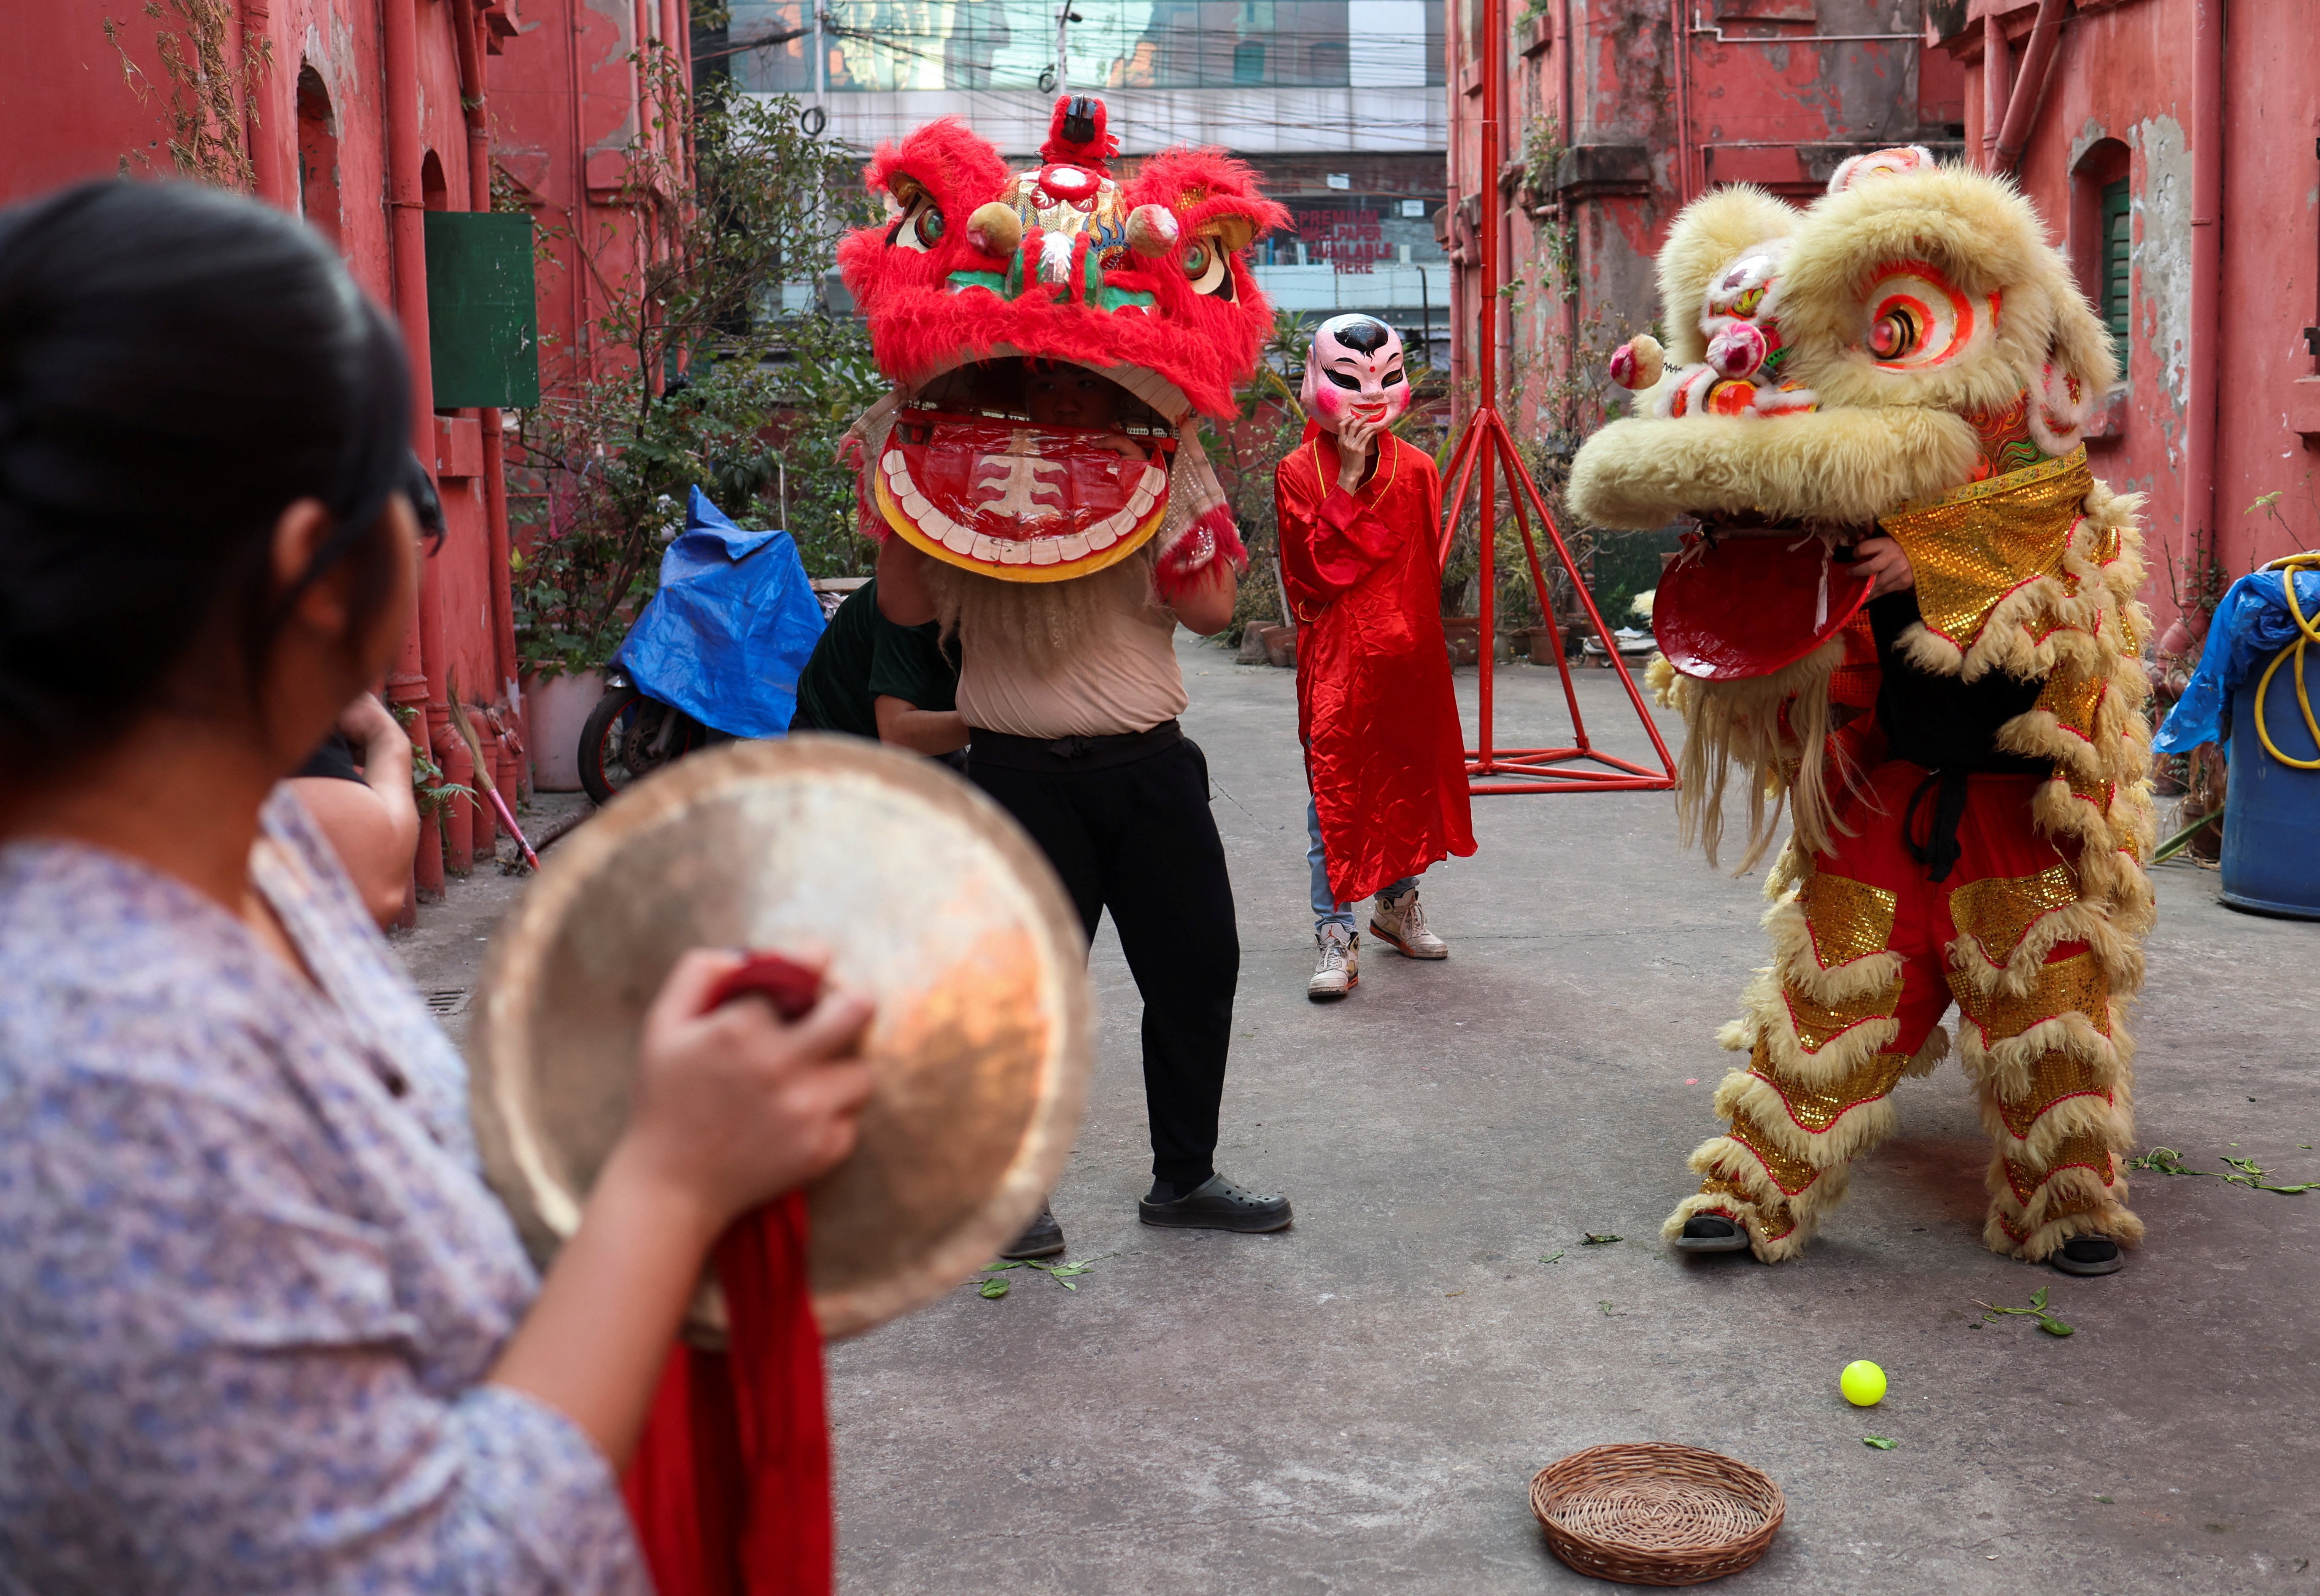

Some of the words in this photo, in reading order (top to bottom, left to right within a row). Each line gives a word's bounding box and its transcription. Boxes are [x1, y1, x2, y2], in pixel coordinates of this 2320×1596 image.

[1299, 210, 1379, 225] PREMIUM
[1300, 225, 1382, 241] WALLPAPER
[1310, 243, 1393, 259] AVAILABLE
[1334, 259, 1374, 274] HERE
